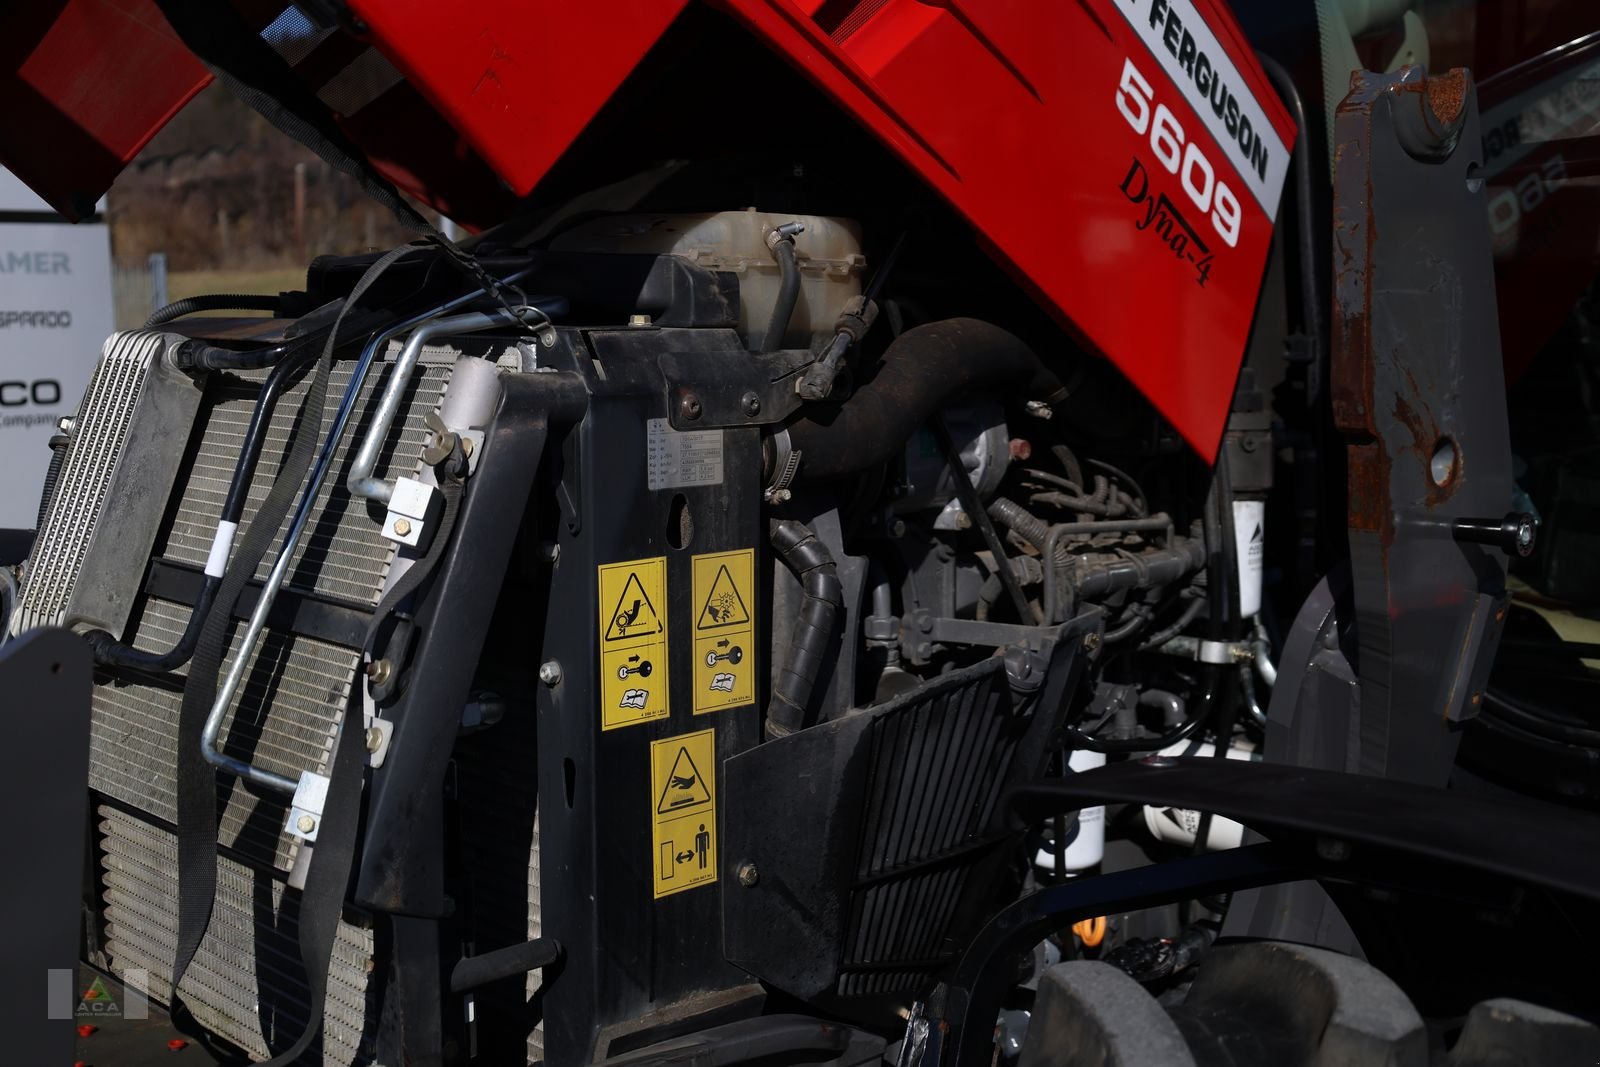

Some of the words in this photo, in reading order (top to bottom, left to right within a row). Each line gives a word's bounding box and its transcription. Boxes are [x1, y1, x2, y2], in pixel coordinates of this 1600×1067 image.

[1115, 56, 1242, 248] 5609
[1148, 0, 1268, 183] FERGUSON
[1118, 156, 1216, 289] Dyna-4
